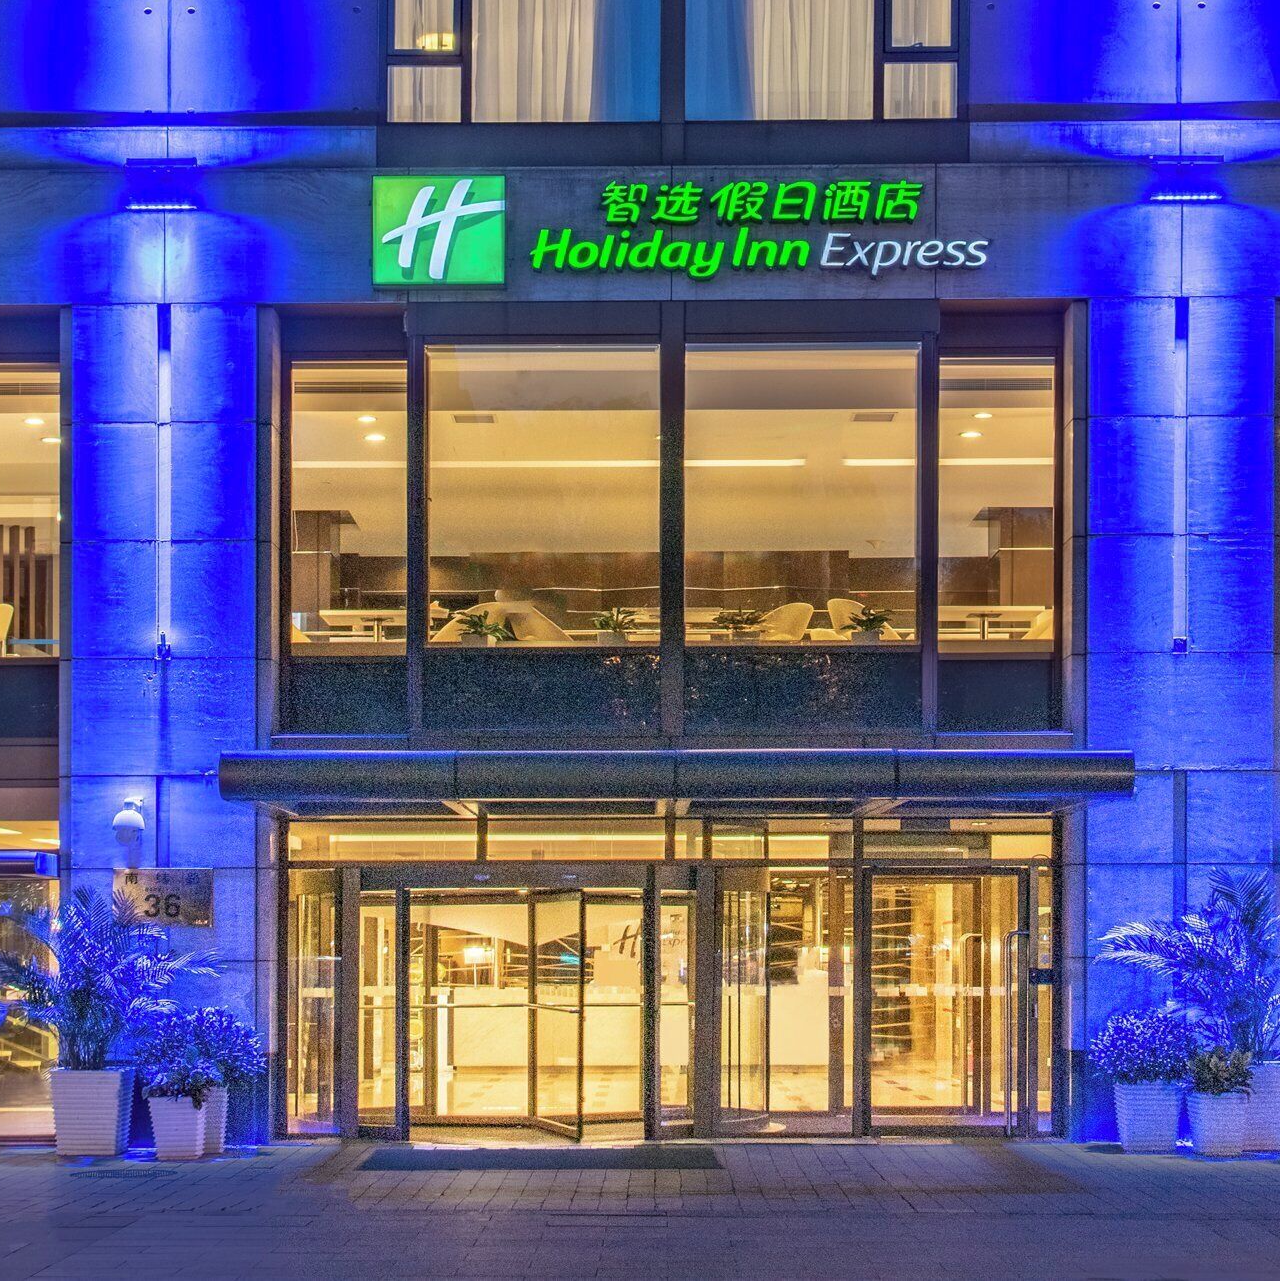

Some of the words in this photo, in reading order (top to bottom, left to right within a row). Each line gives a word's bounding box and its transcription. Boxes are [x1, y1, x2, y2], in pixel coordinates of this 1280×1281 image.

[602, 180, 922, 222] 智选假日酒店
[530, 229, 724, 278] Holiday
[732, 227, 810, 267] Inn
[820, 233, 989, 275] Express
[144, 894, 181, 917] 36
